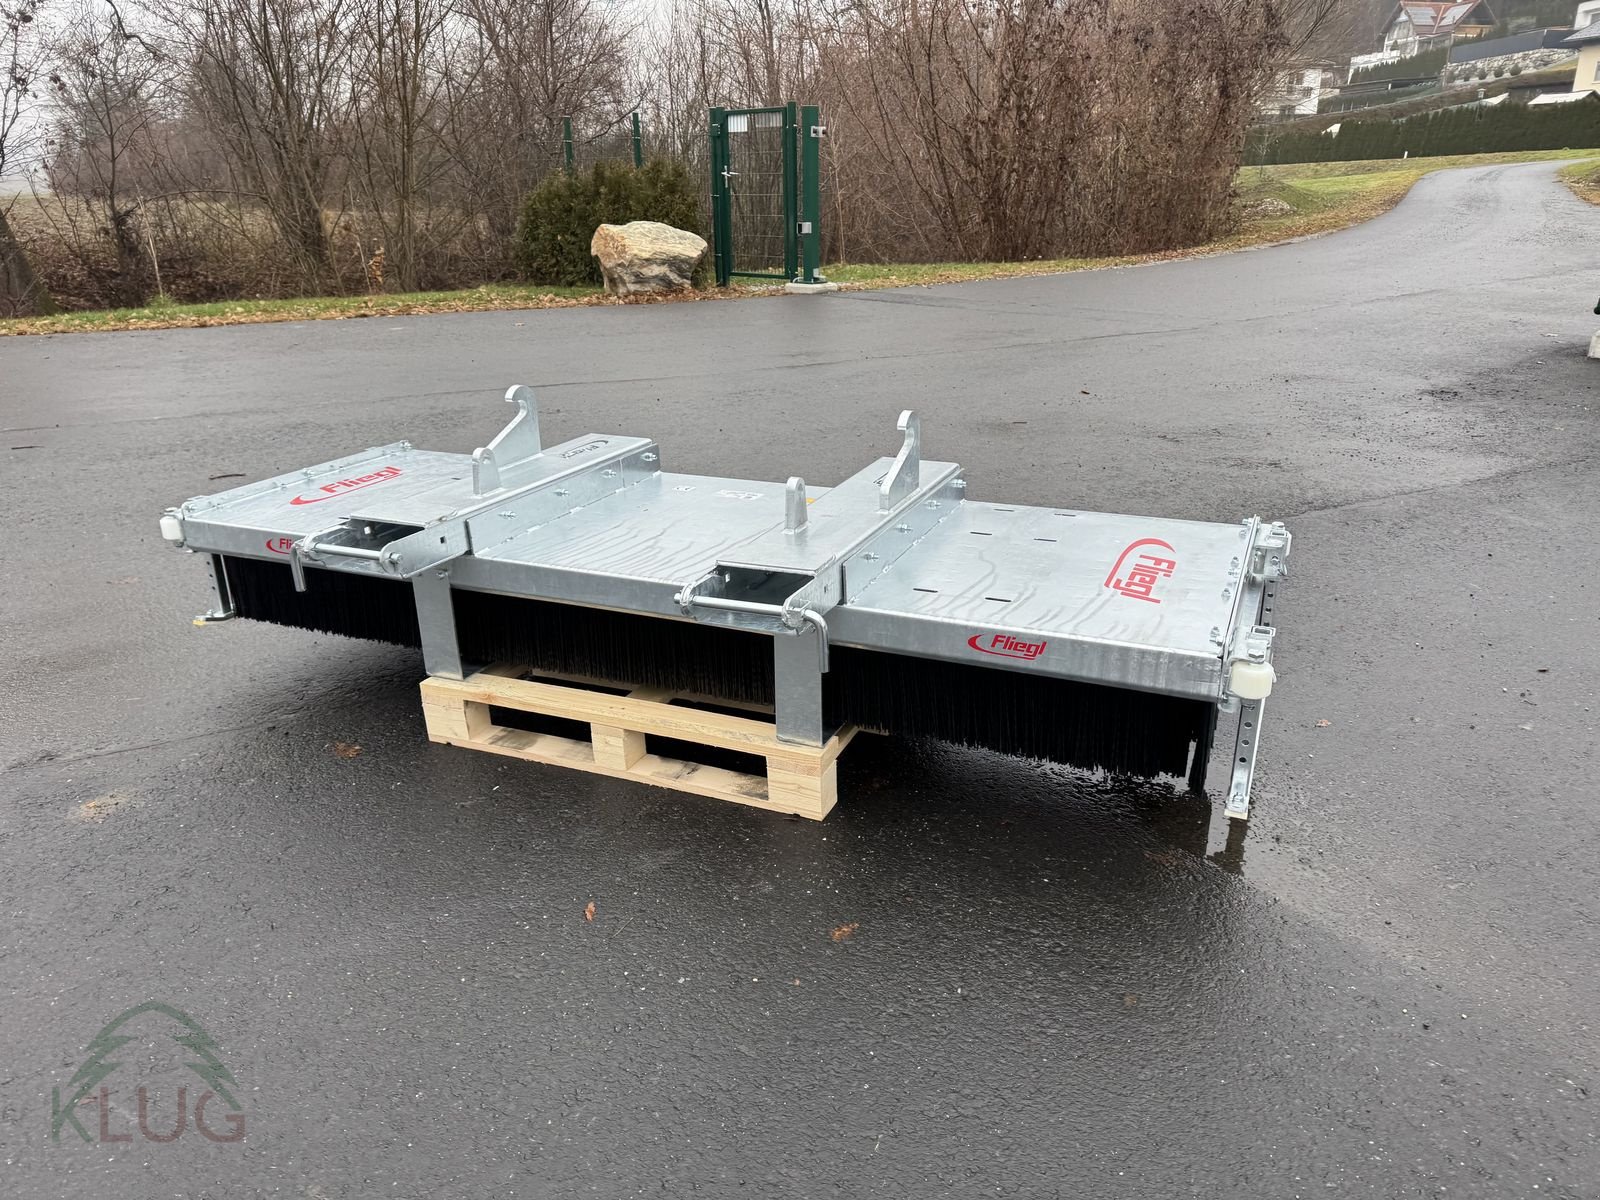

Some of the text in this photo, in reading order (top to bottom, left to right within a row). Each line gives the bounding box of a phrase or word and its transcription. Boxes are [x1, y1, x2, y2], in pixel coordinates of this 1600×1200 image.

[320, 466, 402, 493] Fliegl
[279, 537, 294, 549] Fli
[1113, 554, 1176, 604] Fliegl
[991, 634, 1047, 657] Fliegl
